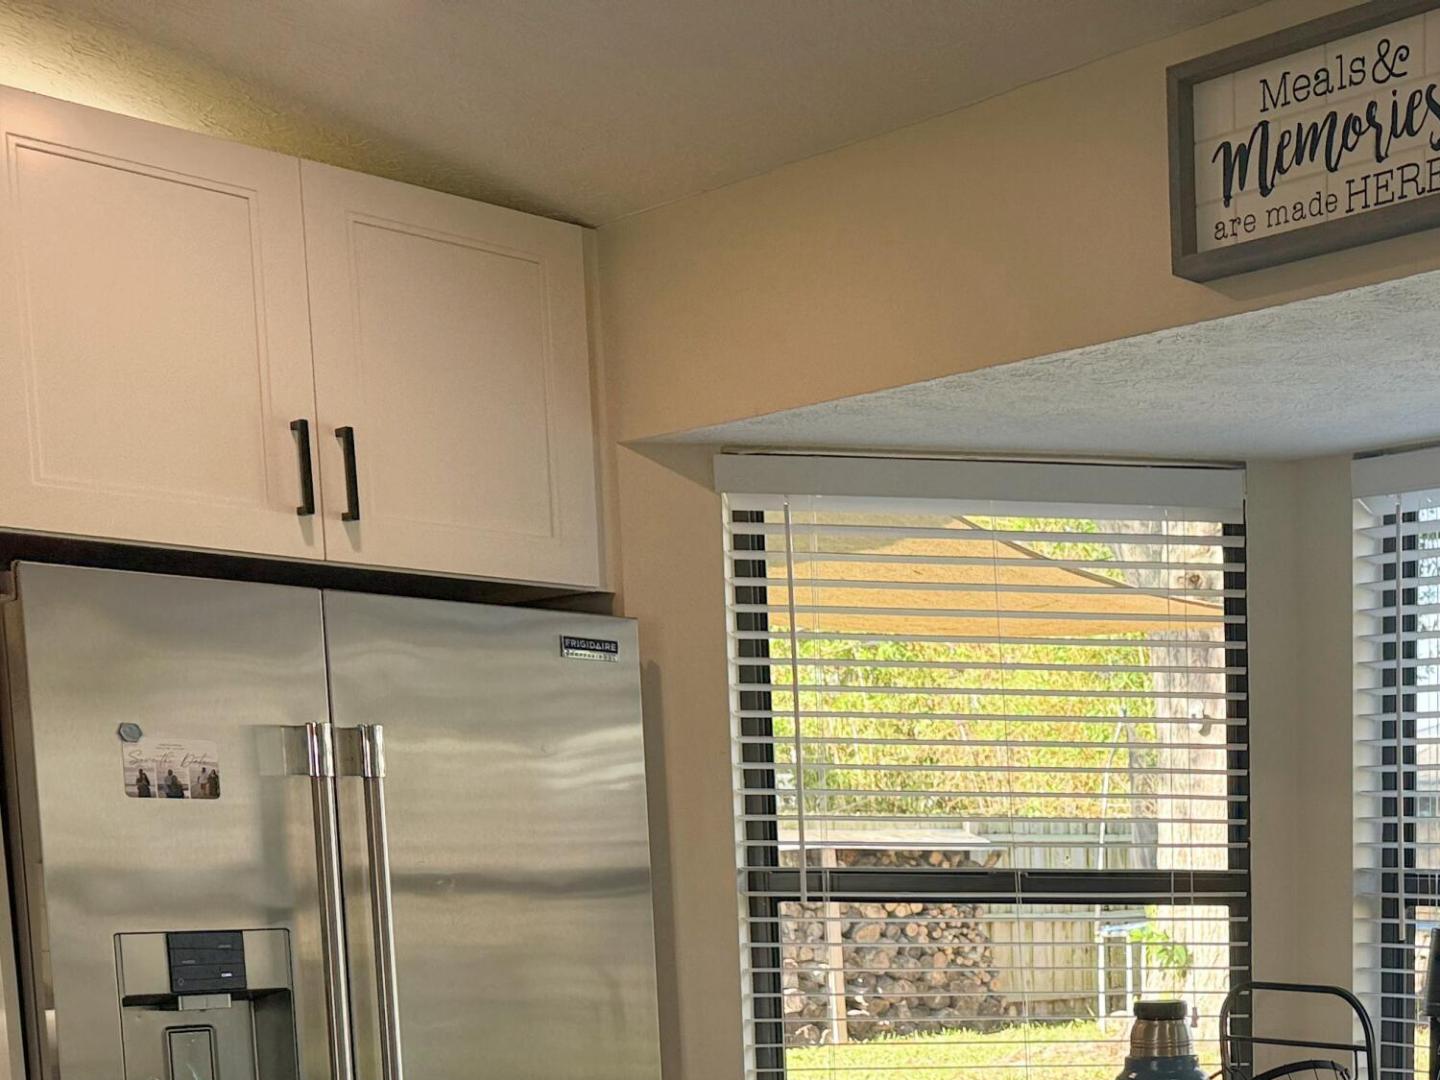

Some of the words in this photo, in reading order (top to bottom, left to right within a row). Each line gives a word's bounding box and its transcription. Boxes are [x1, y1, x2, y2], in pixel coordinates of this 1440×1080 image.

[1214, 213, 1257, 240] are
[1266, 191, 1338, 228] made
[565, 639, 617, 652] FRIGIDAIRE
